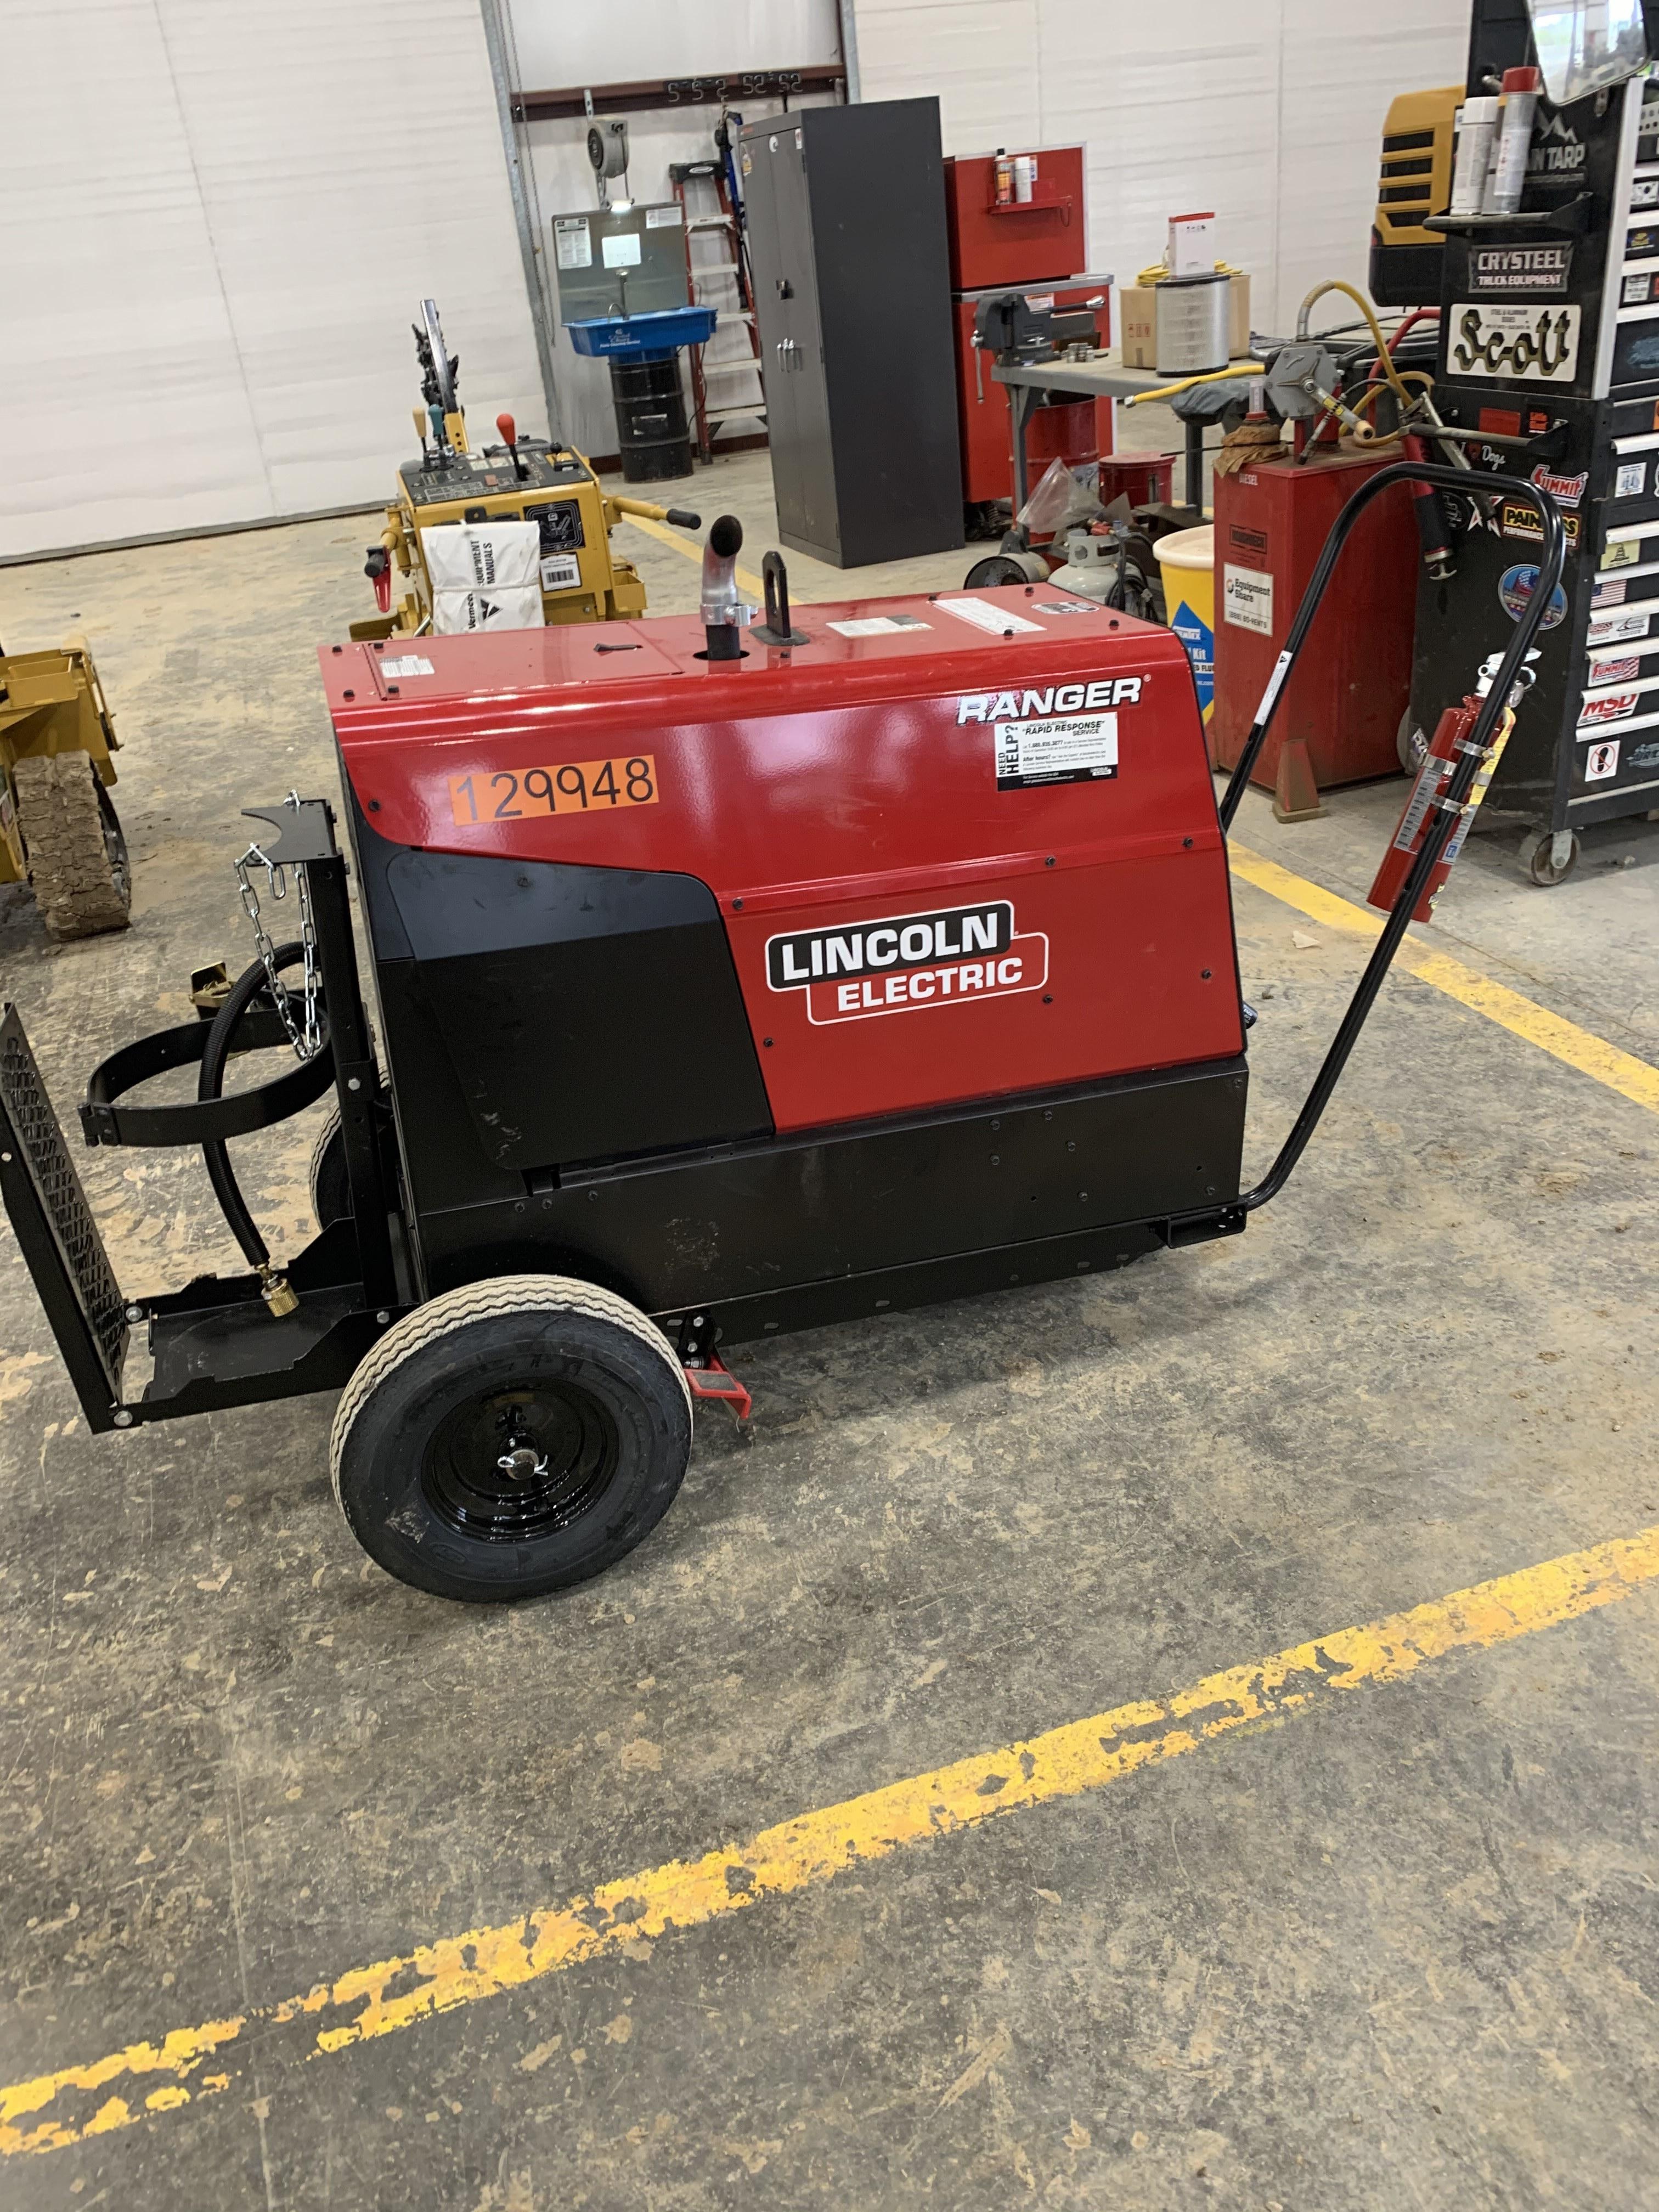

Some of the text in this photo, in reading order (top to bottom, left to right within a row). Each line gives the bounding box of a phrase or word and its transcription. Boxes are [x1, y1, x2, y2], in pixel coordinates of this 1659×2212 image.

[1547, 144, 1585, 170] TARP
[1477, 250, 1565, 270] CRYSTEEL
[1478, 275, 1562, 285] TRUCK EQUIPMENT
[1482, 445, 1506, 471] Dogs
[1239, 473, 1259, 486] DIESEL
[483, 542, 495, 584] MANUALS
[1235, 578, 1271, 596] Equipment
[1235, 589, 1254, 602] Share
[1192, 648, 1206, 661] Kit
[957, 677, 1142, 725] RANGER
[1582, 693, 1638, 716] MSD
[1005, 725, 1019, 774] HELP?
[455, 758, 654, 821] 129948
[782, 912, 998, 981] LINCOLN
[837, 957, 1023, 1012] ELECTRIC
